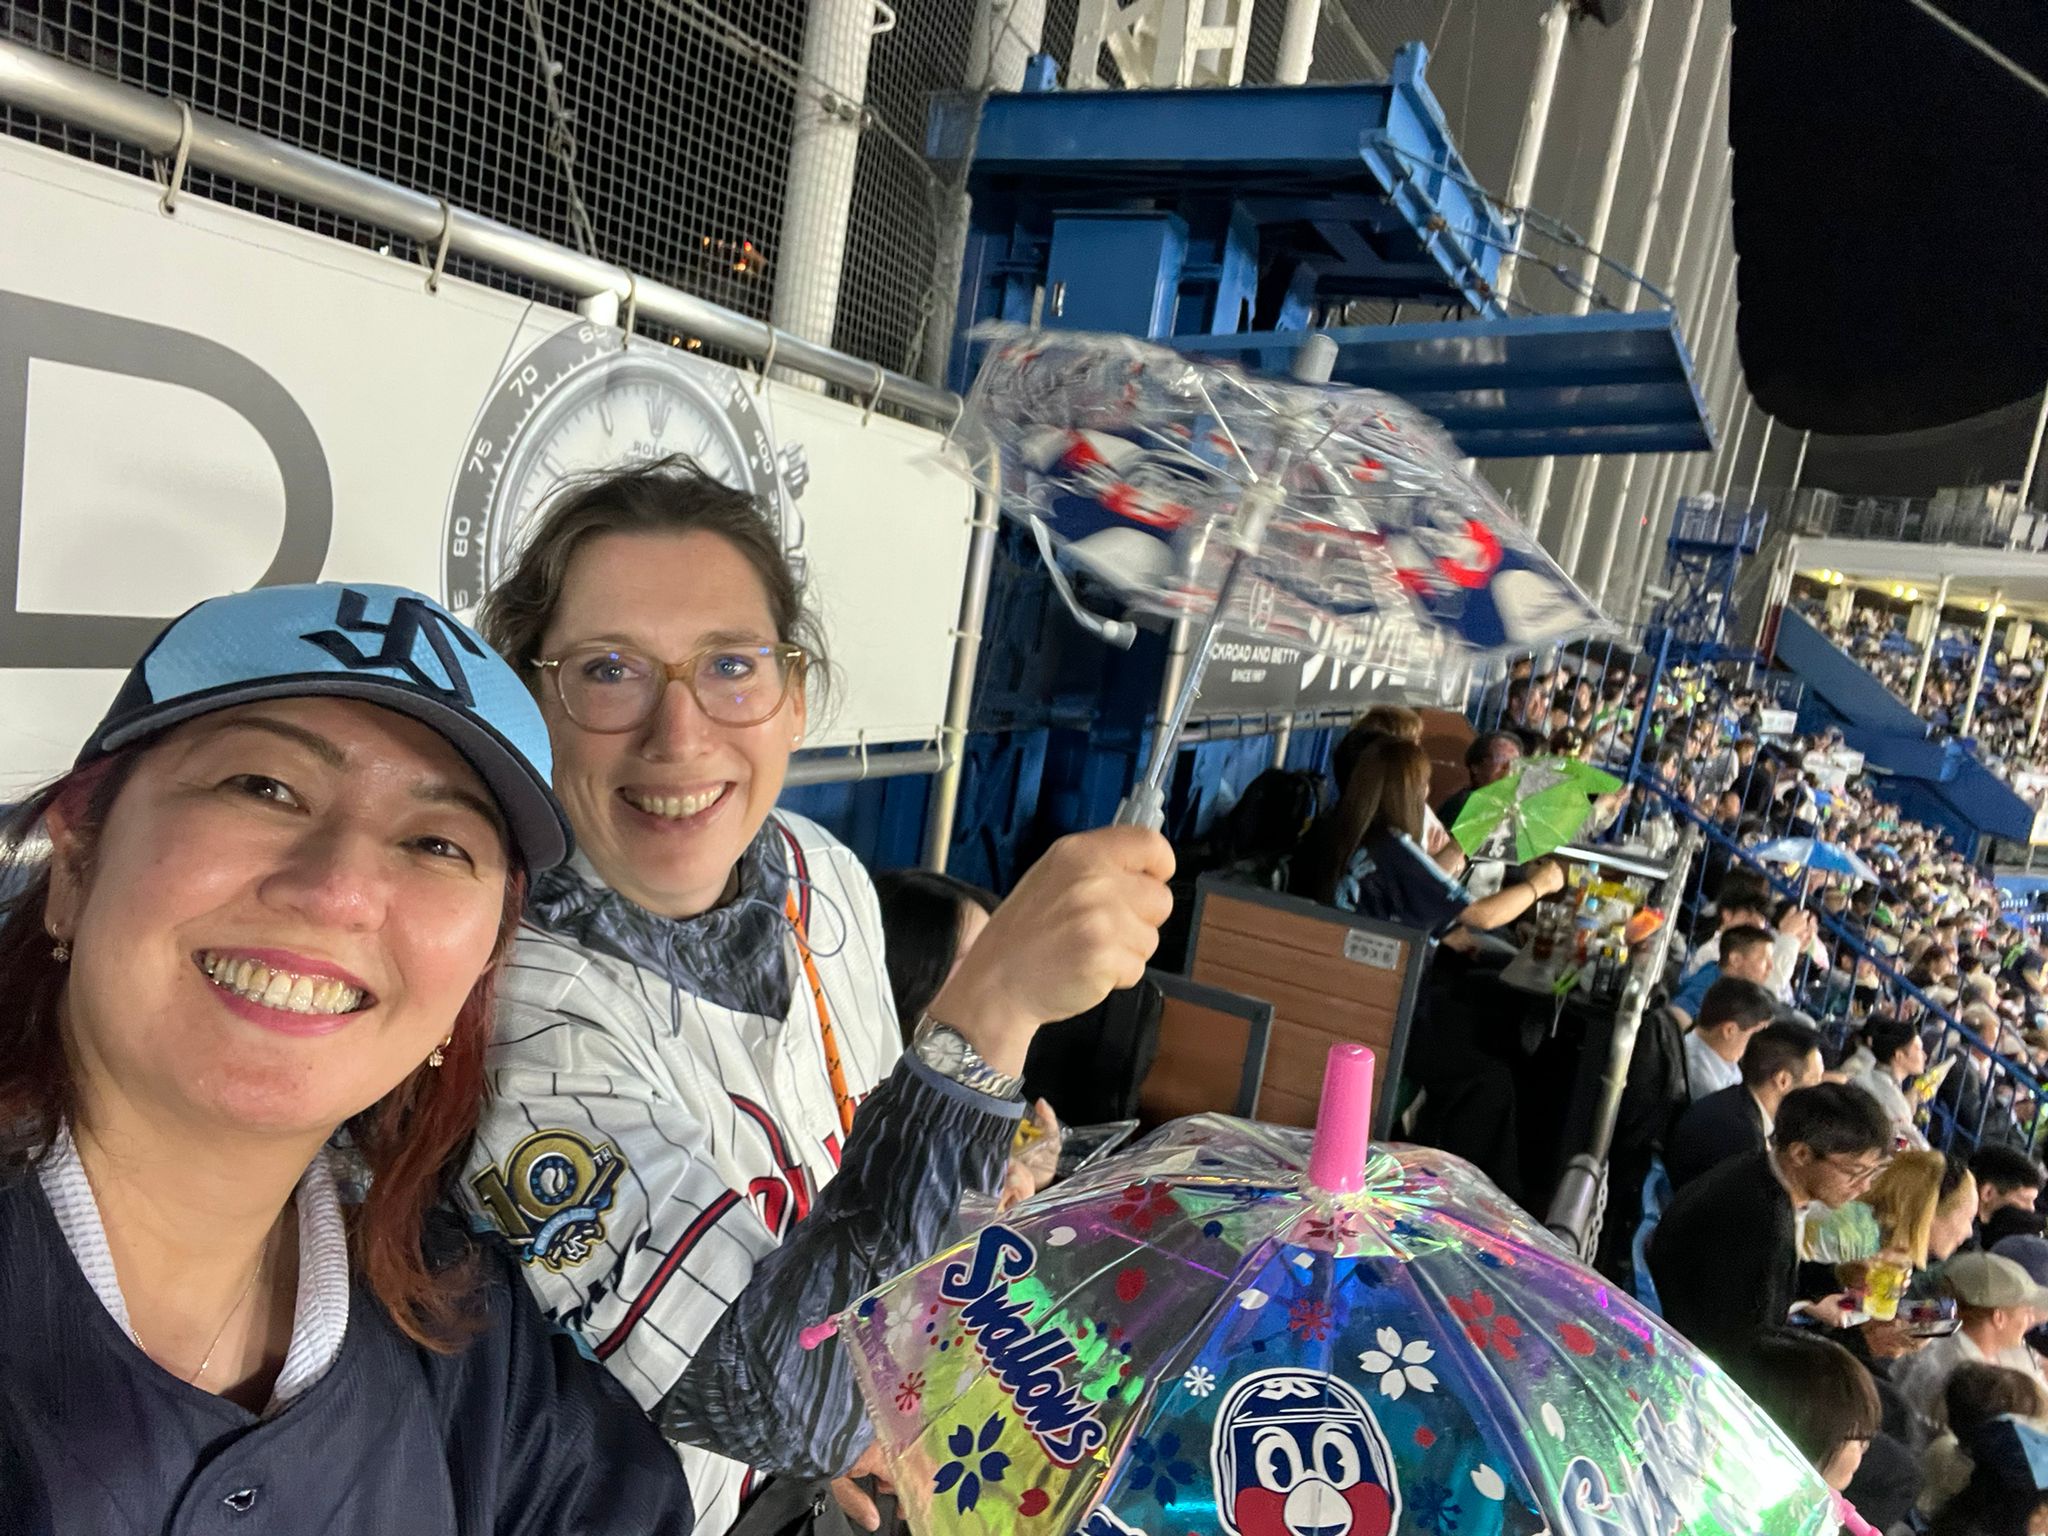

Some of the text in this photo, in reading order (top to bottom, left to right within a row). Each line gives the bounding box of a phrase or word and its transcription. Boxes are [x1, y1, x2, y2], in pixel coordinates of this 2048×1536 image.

[509, 364, 539, 398] 70
[468, 439, 493, 474] 75
[753, 429, 774, 475] 400
[452, 515, 472, 558] 80
[1211, 642, 1300, 665] CKROAD AND BETTY
[939, 1225, 1106, 1469] Swallows
